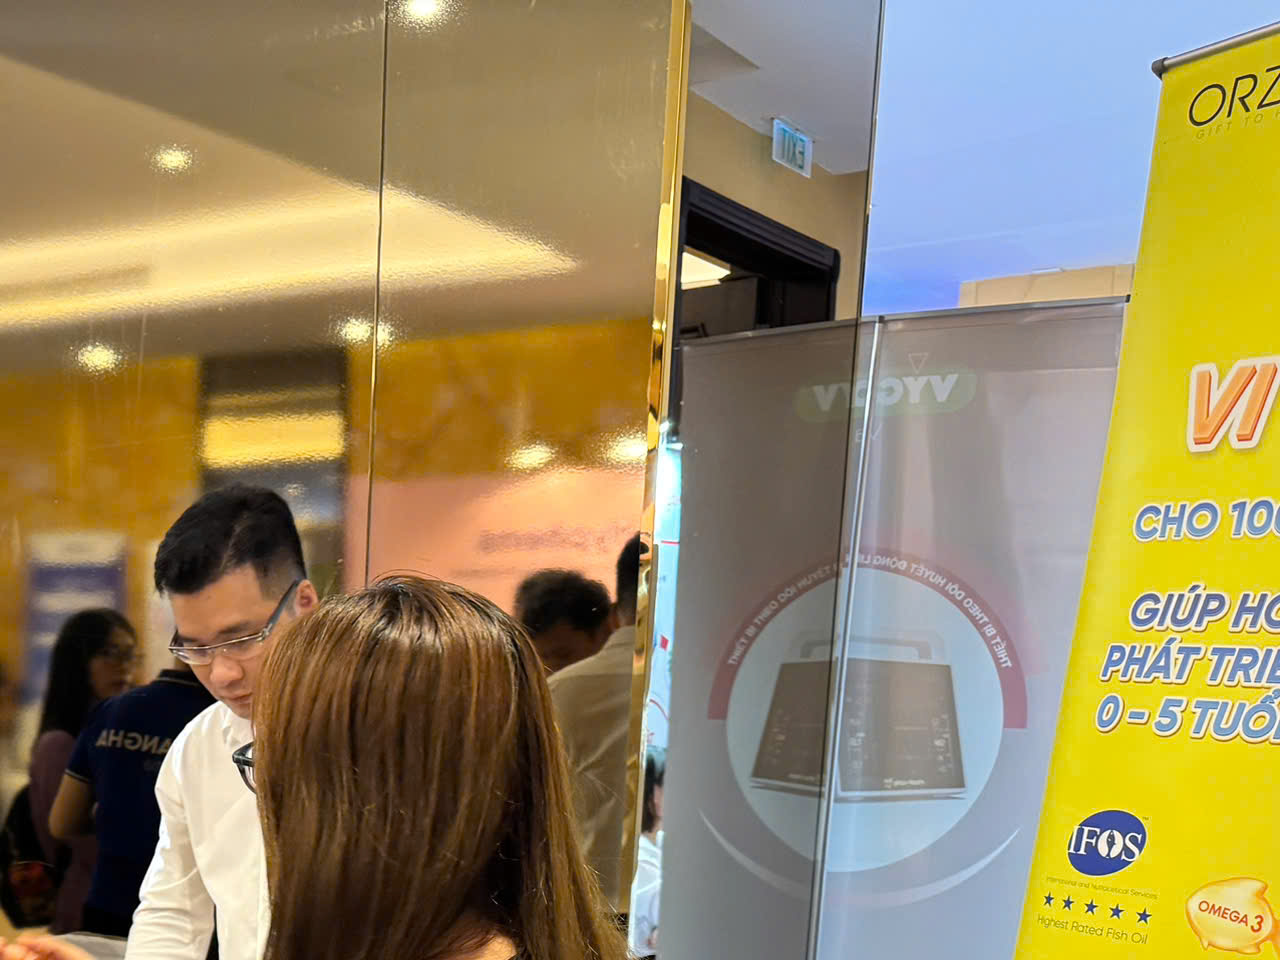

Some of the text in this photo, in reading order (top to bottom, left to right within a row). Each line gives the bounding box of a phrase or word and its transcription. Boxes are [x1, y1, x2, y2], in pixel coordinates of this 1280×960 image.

[1196, 113, 1264, 140] GIFT TO
[1134, 499, 1280, 541] CHO 10
[1130, 583, 1228, 631] GIÚP
[1101, 637, 1203, 683] PHÁT
[1096, 694, 1123, 733] 0
[1128, 710, 1149, 723] -
[1153, 697, 1186, 736] 5
[1067, 826, 1142, 862] IFOS
[1037, 914, 1148, 945] Highest Rated Fish Oil
[1198, 900, 1265, 933] OMEGA 3
